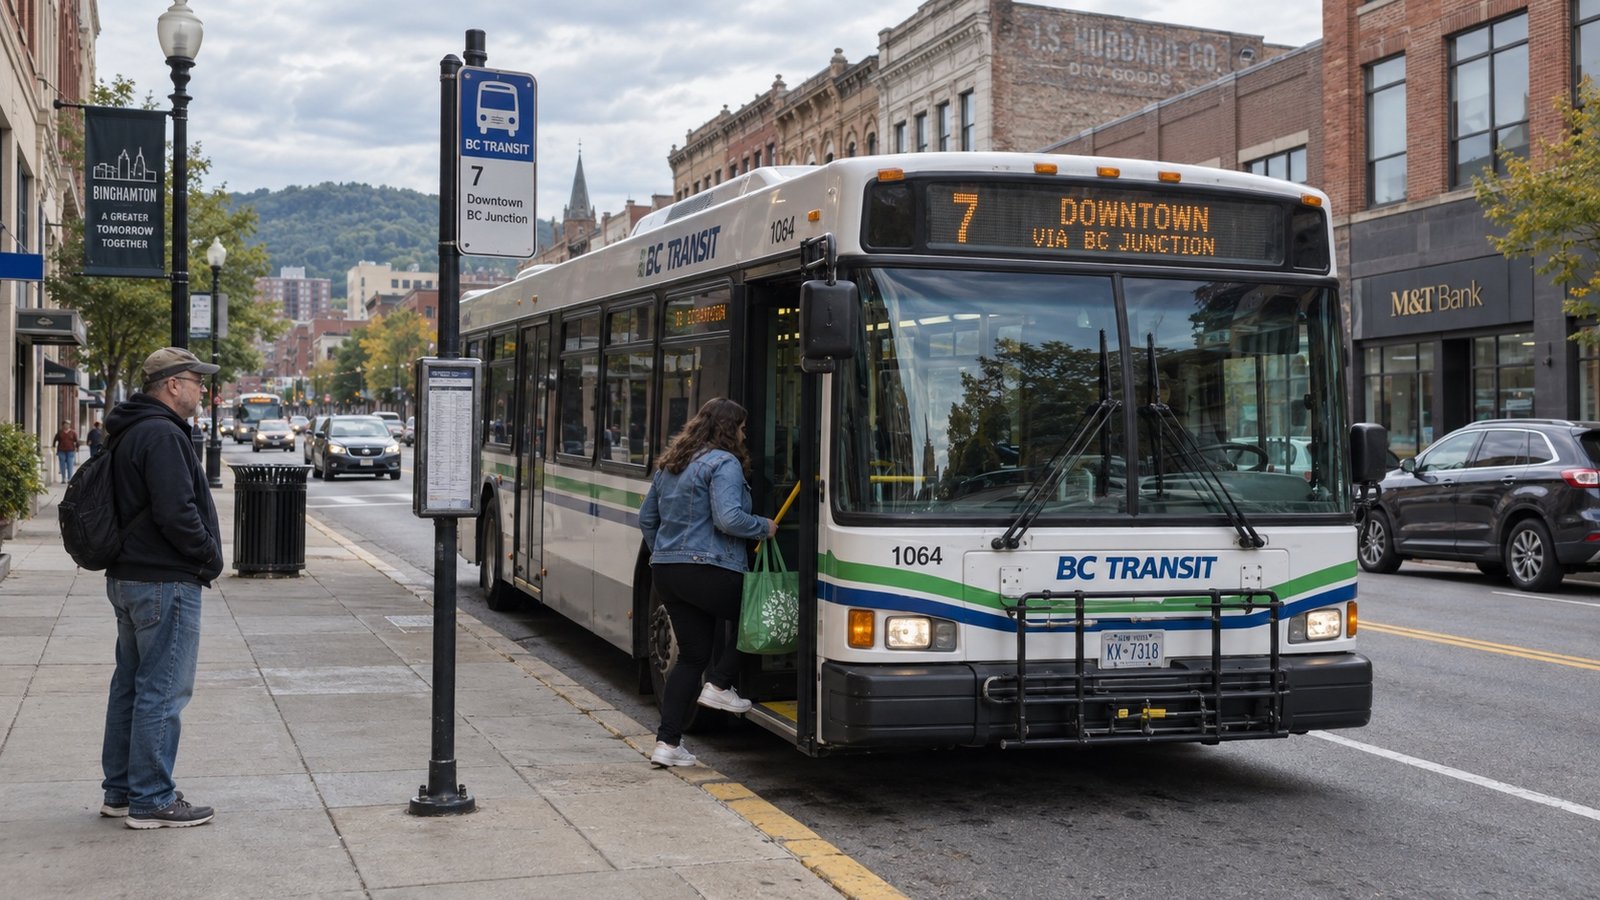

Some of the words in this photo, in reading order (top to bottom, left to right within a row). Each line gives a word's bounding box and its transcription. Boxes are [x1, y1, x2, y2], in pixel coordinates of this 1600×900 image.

[1069, 62, 1104, 79] DRY
[1111, 67, 1171, 87] GOODS
[465, 138, 480, 150] BC
[483, 140, 530, 155] TRANSIT
[471, 165, 484, 186] 7
[93, 185, 157, 203] BINGHAMTON
[467, 193, 523, 208] Downtown
[101, 212, 108, 221] A
[110, 212, 149, 222] GREATER
[467, 209, 482, 221] BC
[485, 211, 528, 225] Junction
[953, 192, 978, 243] 7
[1060, 198, 1209, 233] DOWNTOWN
[96, 224, 154, 236] TOMORROW
[770, 216, 795, 245] 1064
[101, 238, 148, 249] TOGETHER
[645, 242, 664, 276] BC
[667, 225, 721, 271] TRANSIT
[1032, 228, 1069, 249] VIA
[1084, 231, 1109, 250] BC
[1118, 233, 1215, 256] JUNCTION
[1391, 286, 1436, 317] M&T
[1438, 280, 1483, 311] Bank
[891, 545, 943, 566] 1064
[1056, 555, 1098, 580] BC
[1105, 556, 1218, 580] TRANSIT
[1107, 643, 1122, 661] KX
[1130, 642, 1159, 660] 7318
